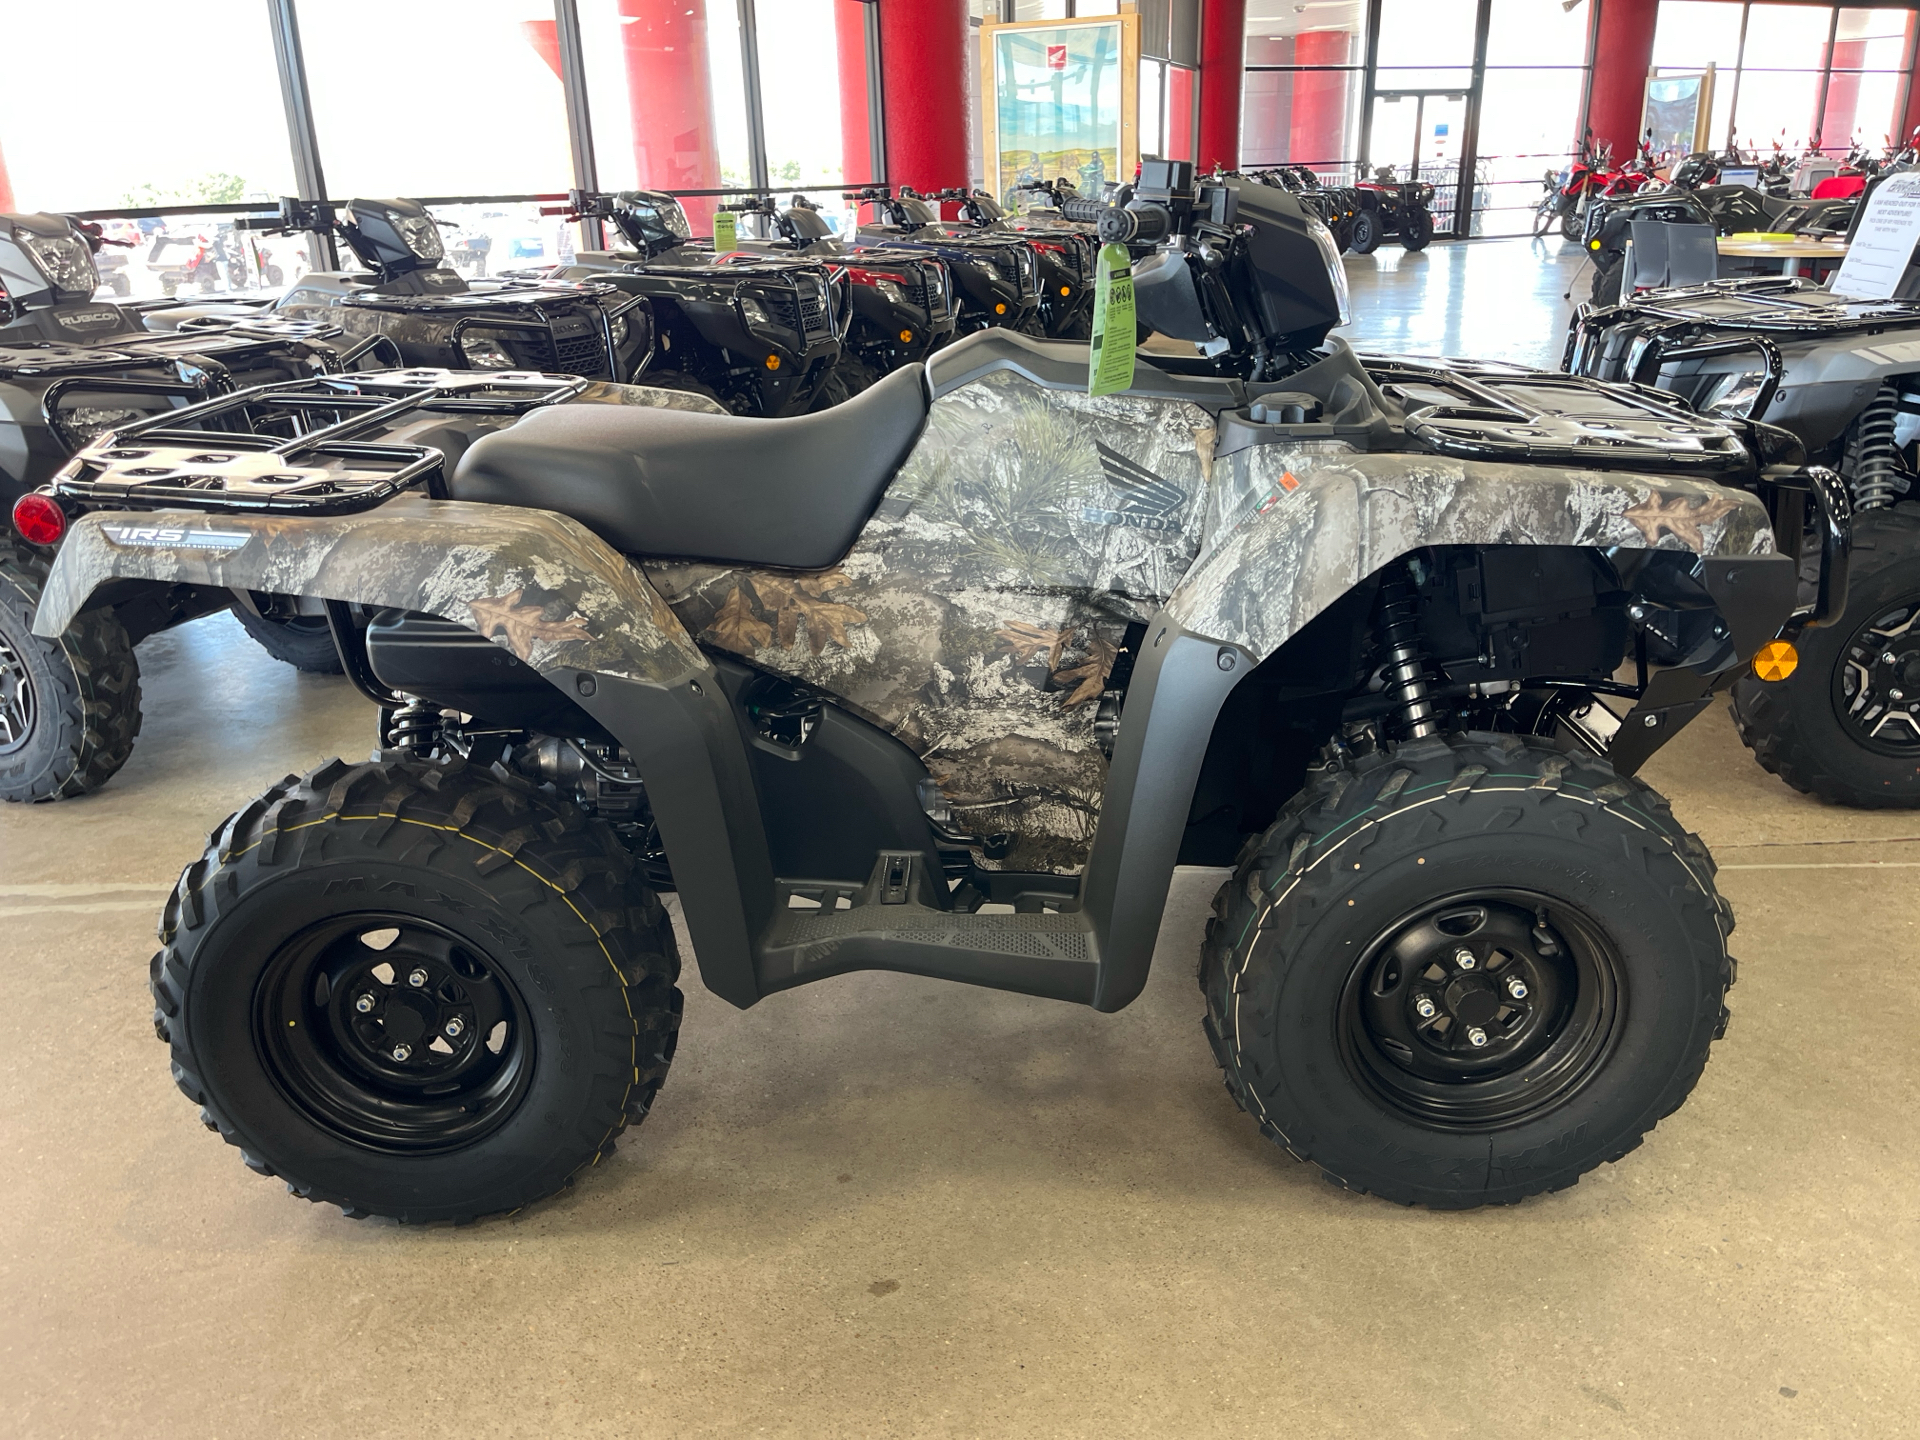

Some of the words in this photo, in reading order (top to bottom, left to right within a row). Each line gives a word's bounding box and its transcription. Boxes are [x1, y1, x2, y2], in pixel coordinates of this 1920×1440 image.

[59, 312, 121, 326] RUBICON
[1083, 506, 1183, 533] HONDA
[119, 527, 185, 541] IRS
[321, 876, 550, 996] MAXXIS
